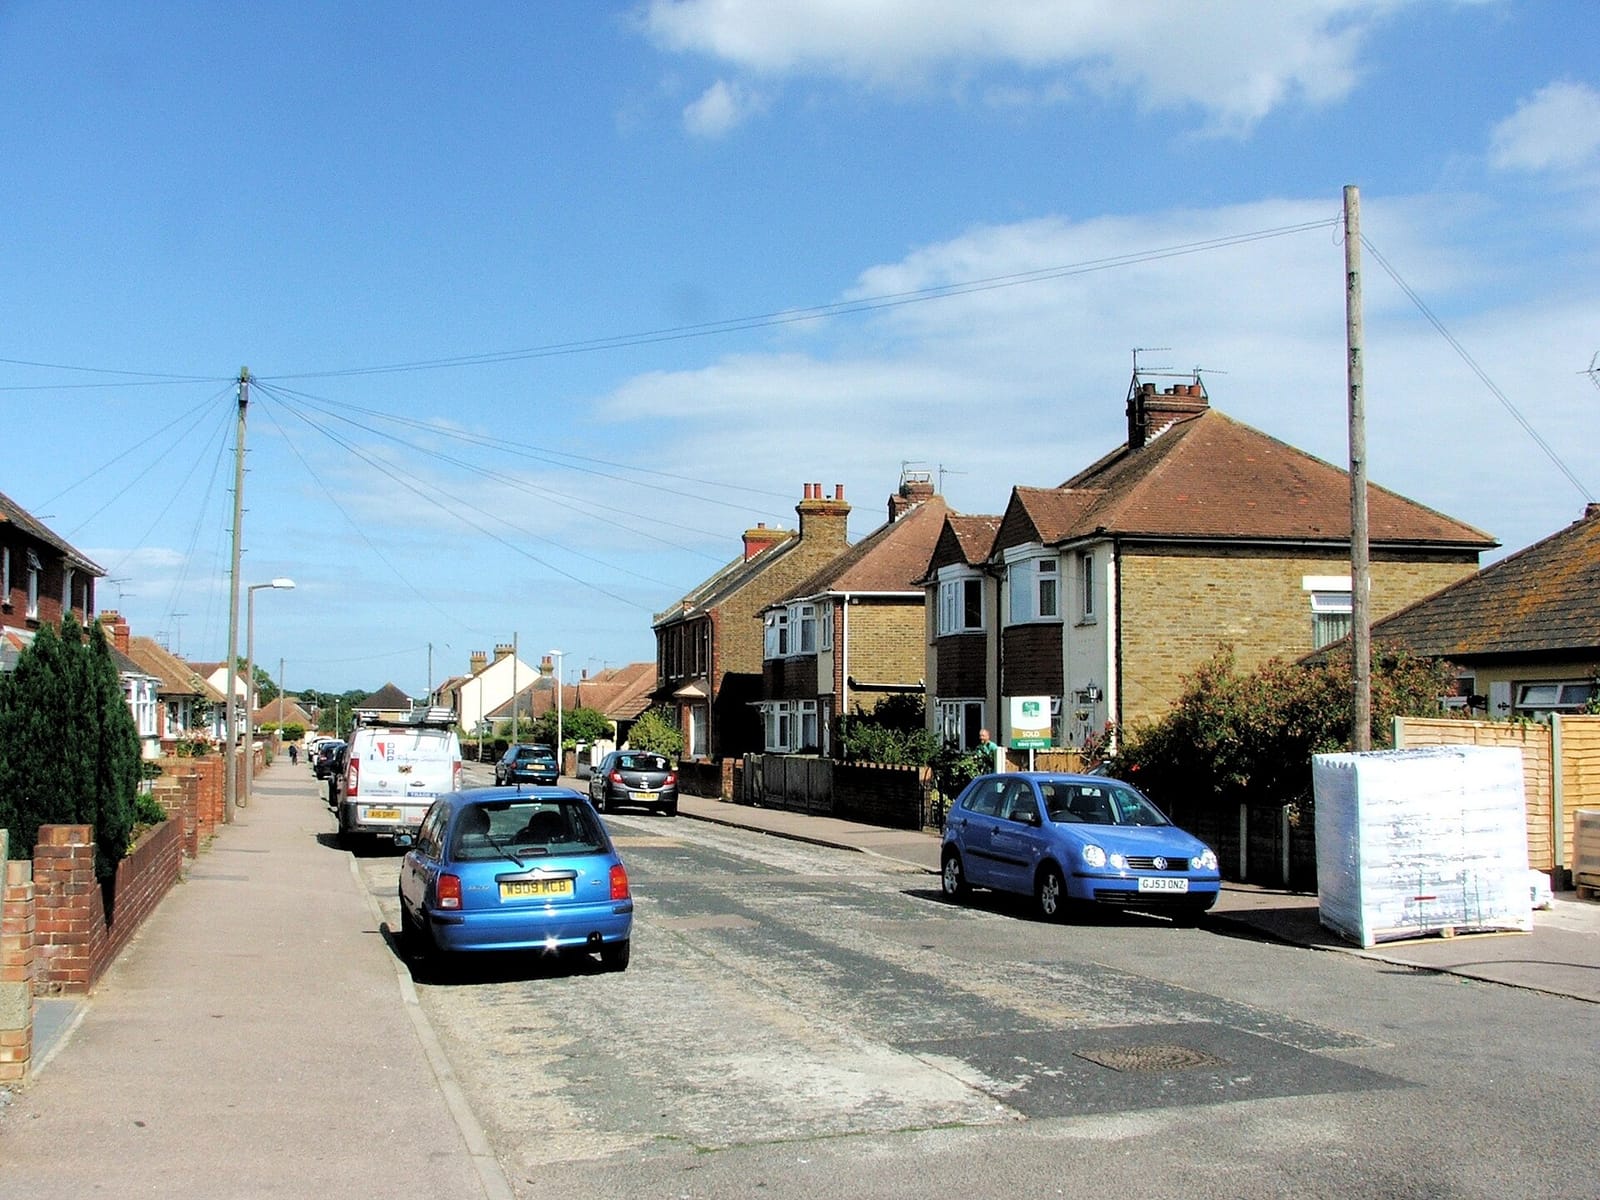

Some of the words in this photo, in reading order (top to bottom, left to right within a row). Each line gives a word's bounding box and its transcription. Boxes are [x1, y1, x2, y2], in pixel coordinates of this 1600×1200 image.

[505, 882, 539, 895] W909
[542, 880, 566, 893] MCB
[1143, 879, 1165, 888] GJ53
[1168, 879, 1185, 889] ONZ
